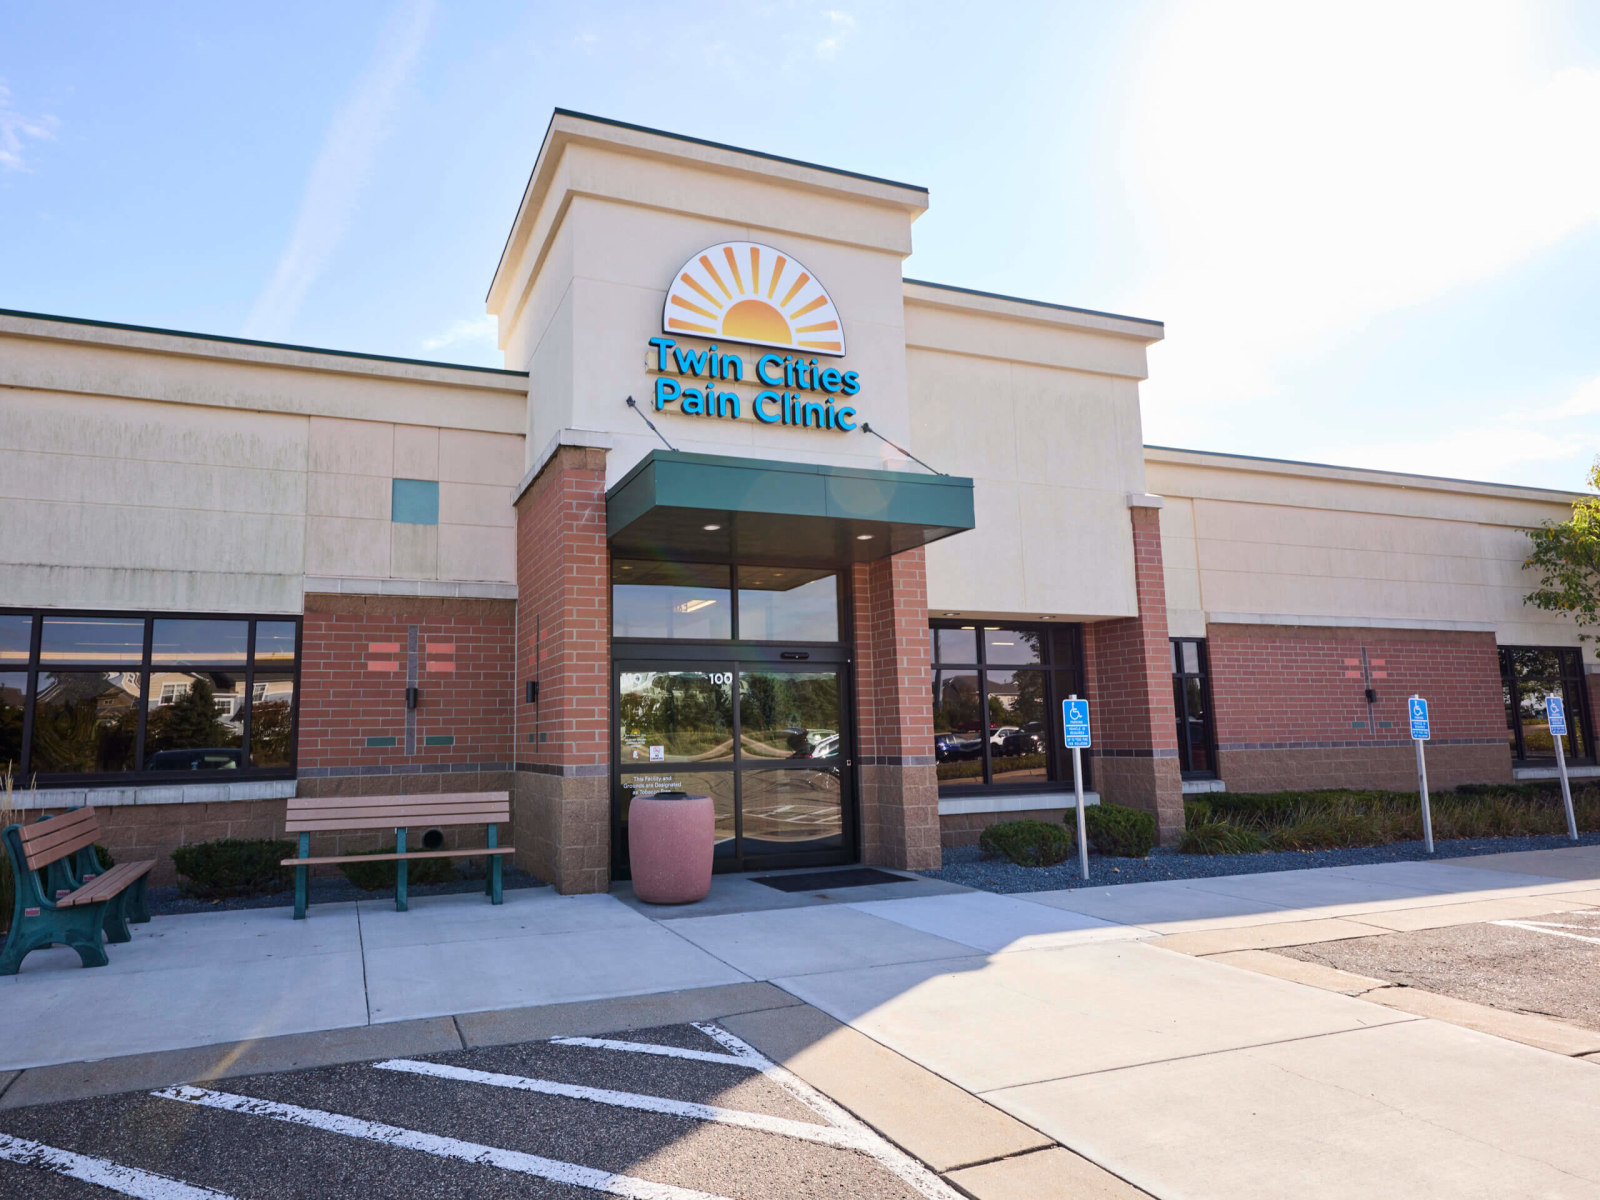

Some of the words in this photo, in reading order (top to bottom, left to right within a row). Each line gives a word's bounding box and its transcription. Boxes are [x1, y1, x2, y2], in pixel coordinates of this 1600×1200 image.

[649, 337, 743, 381] Twin
[756, 353, 860, 395] Cities
[655, 377, 740, 419] Pain
[753, 390, 857, 432] Clinic
[709, 672, 732, 684] 100
